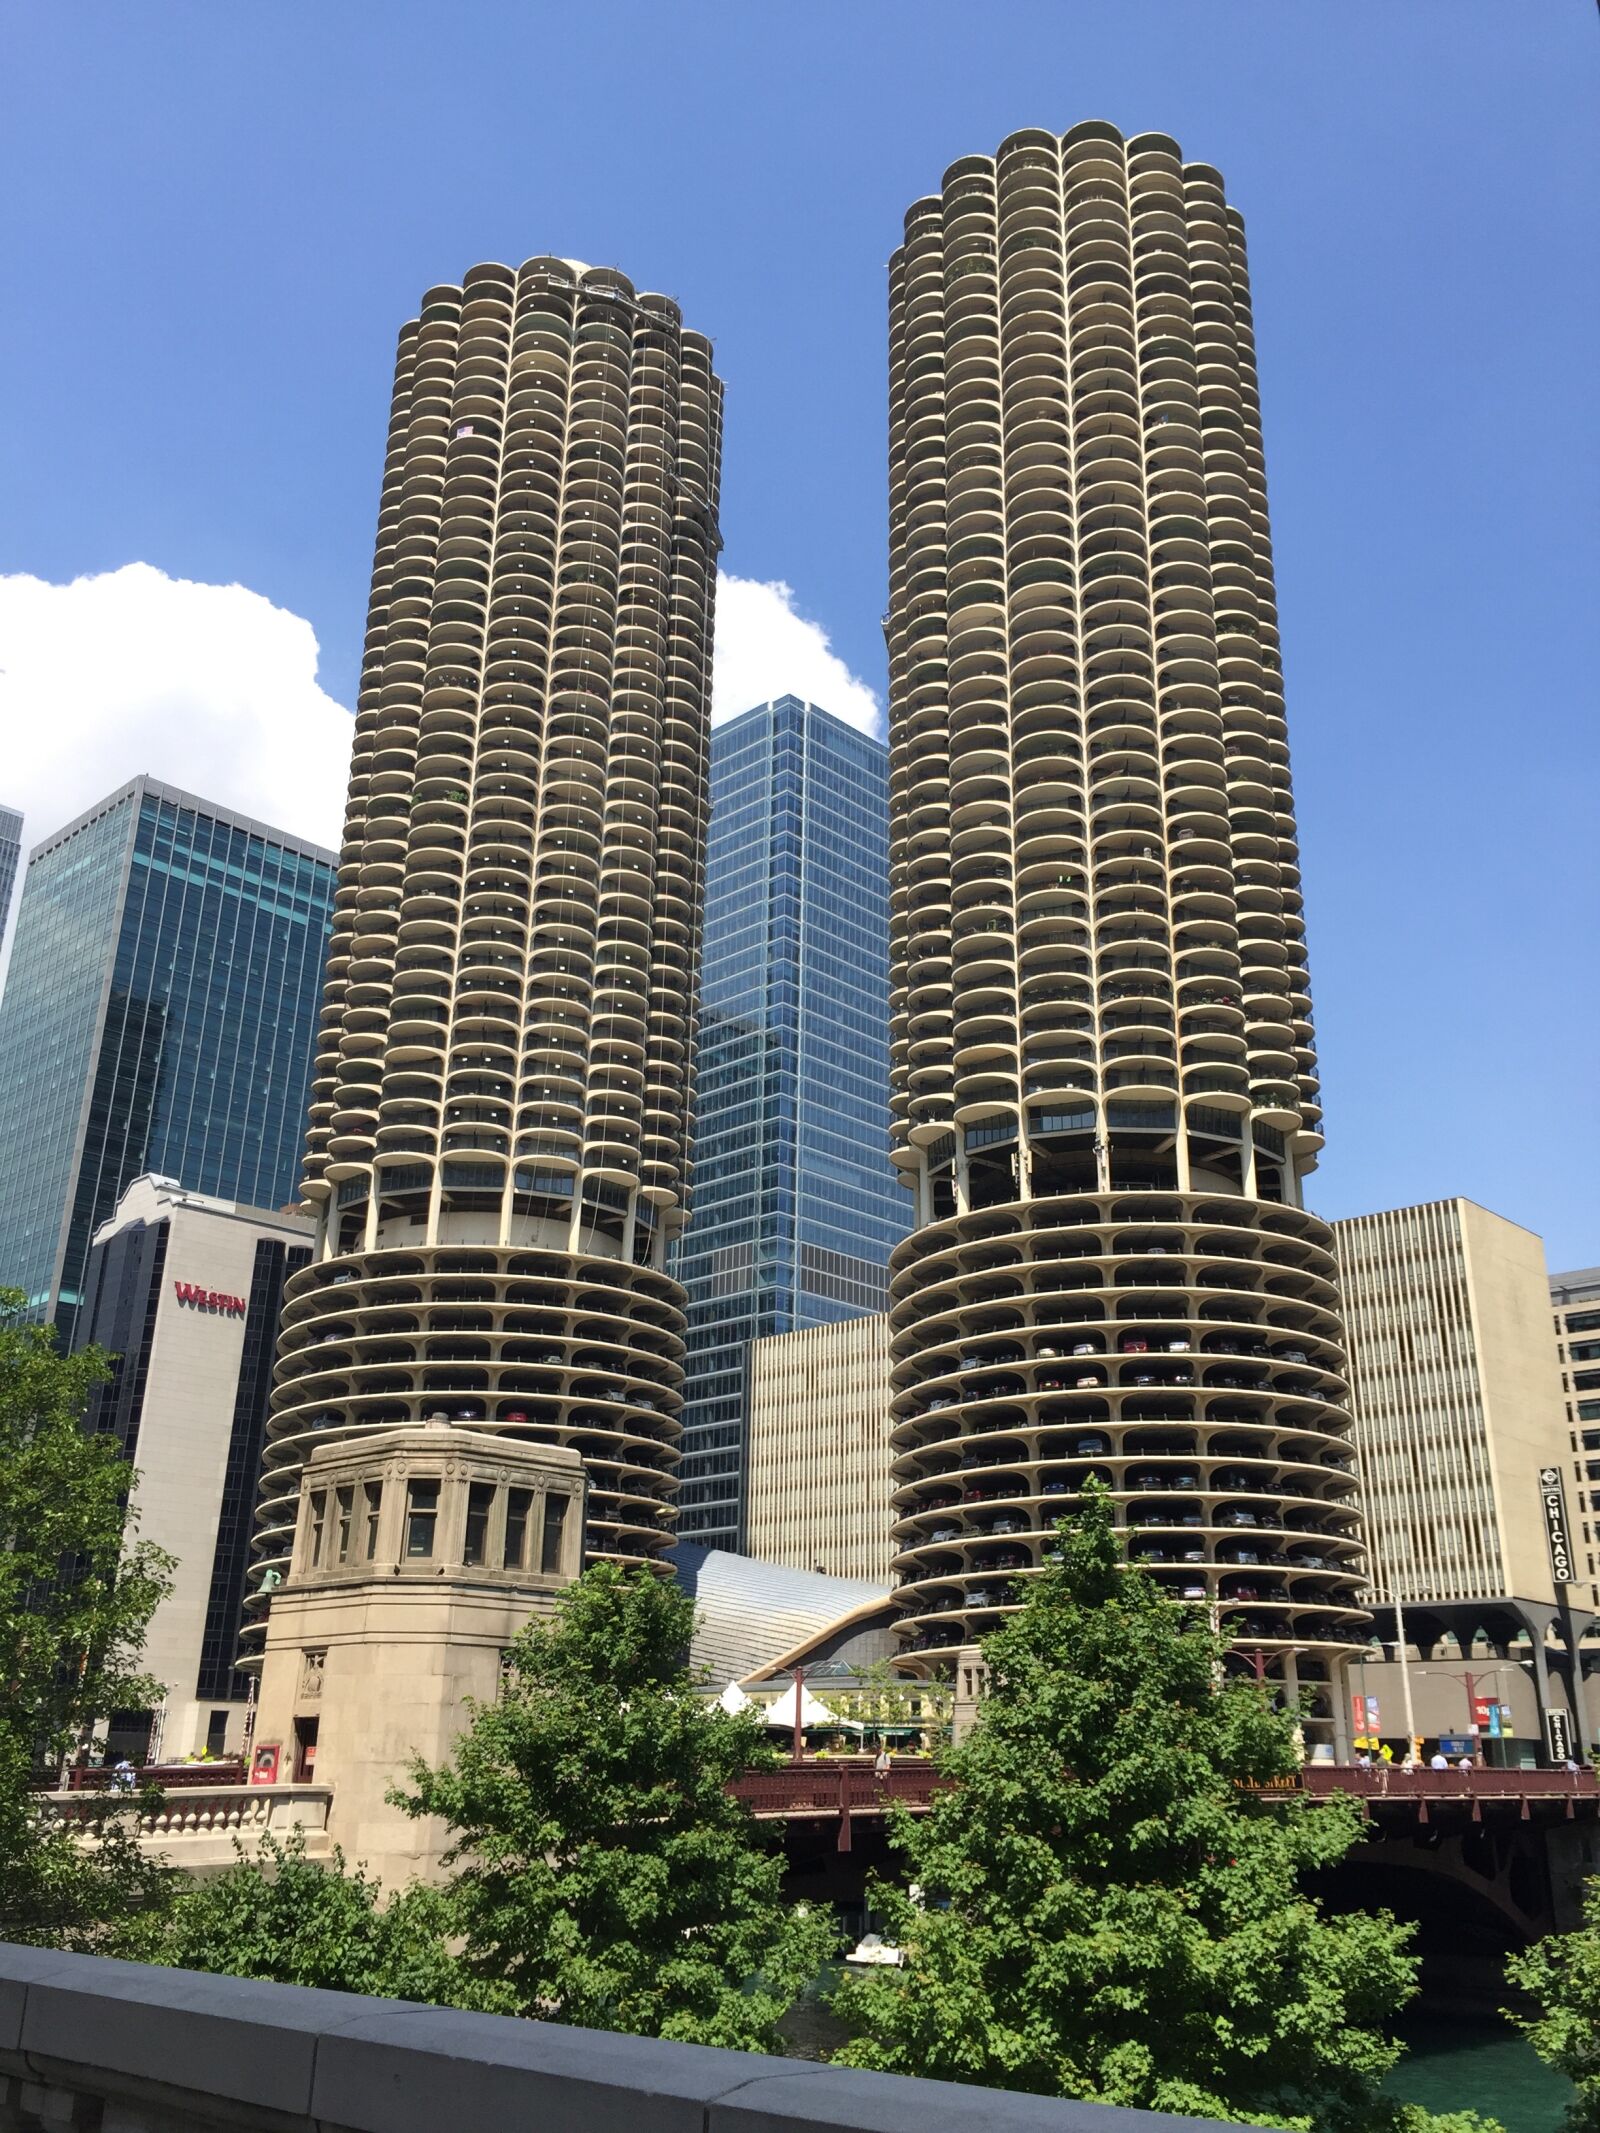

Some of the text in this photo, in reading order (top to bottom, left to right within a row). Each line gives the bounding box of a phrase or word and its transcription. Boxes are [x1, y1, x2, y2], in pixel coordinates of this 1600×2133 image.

[174, 1281, 246, 1314] WESTIN
[1546, 1495, 1569, 1580] CHICAGO
[1552, 1715, 1566, 1760] CHICAGO
